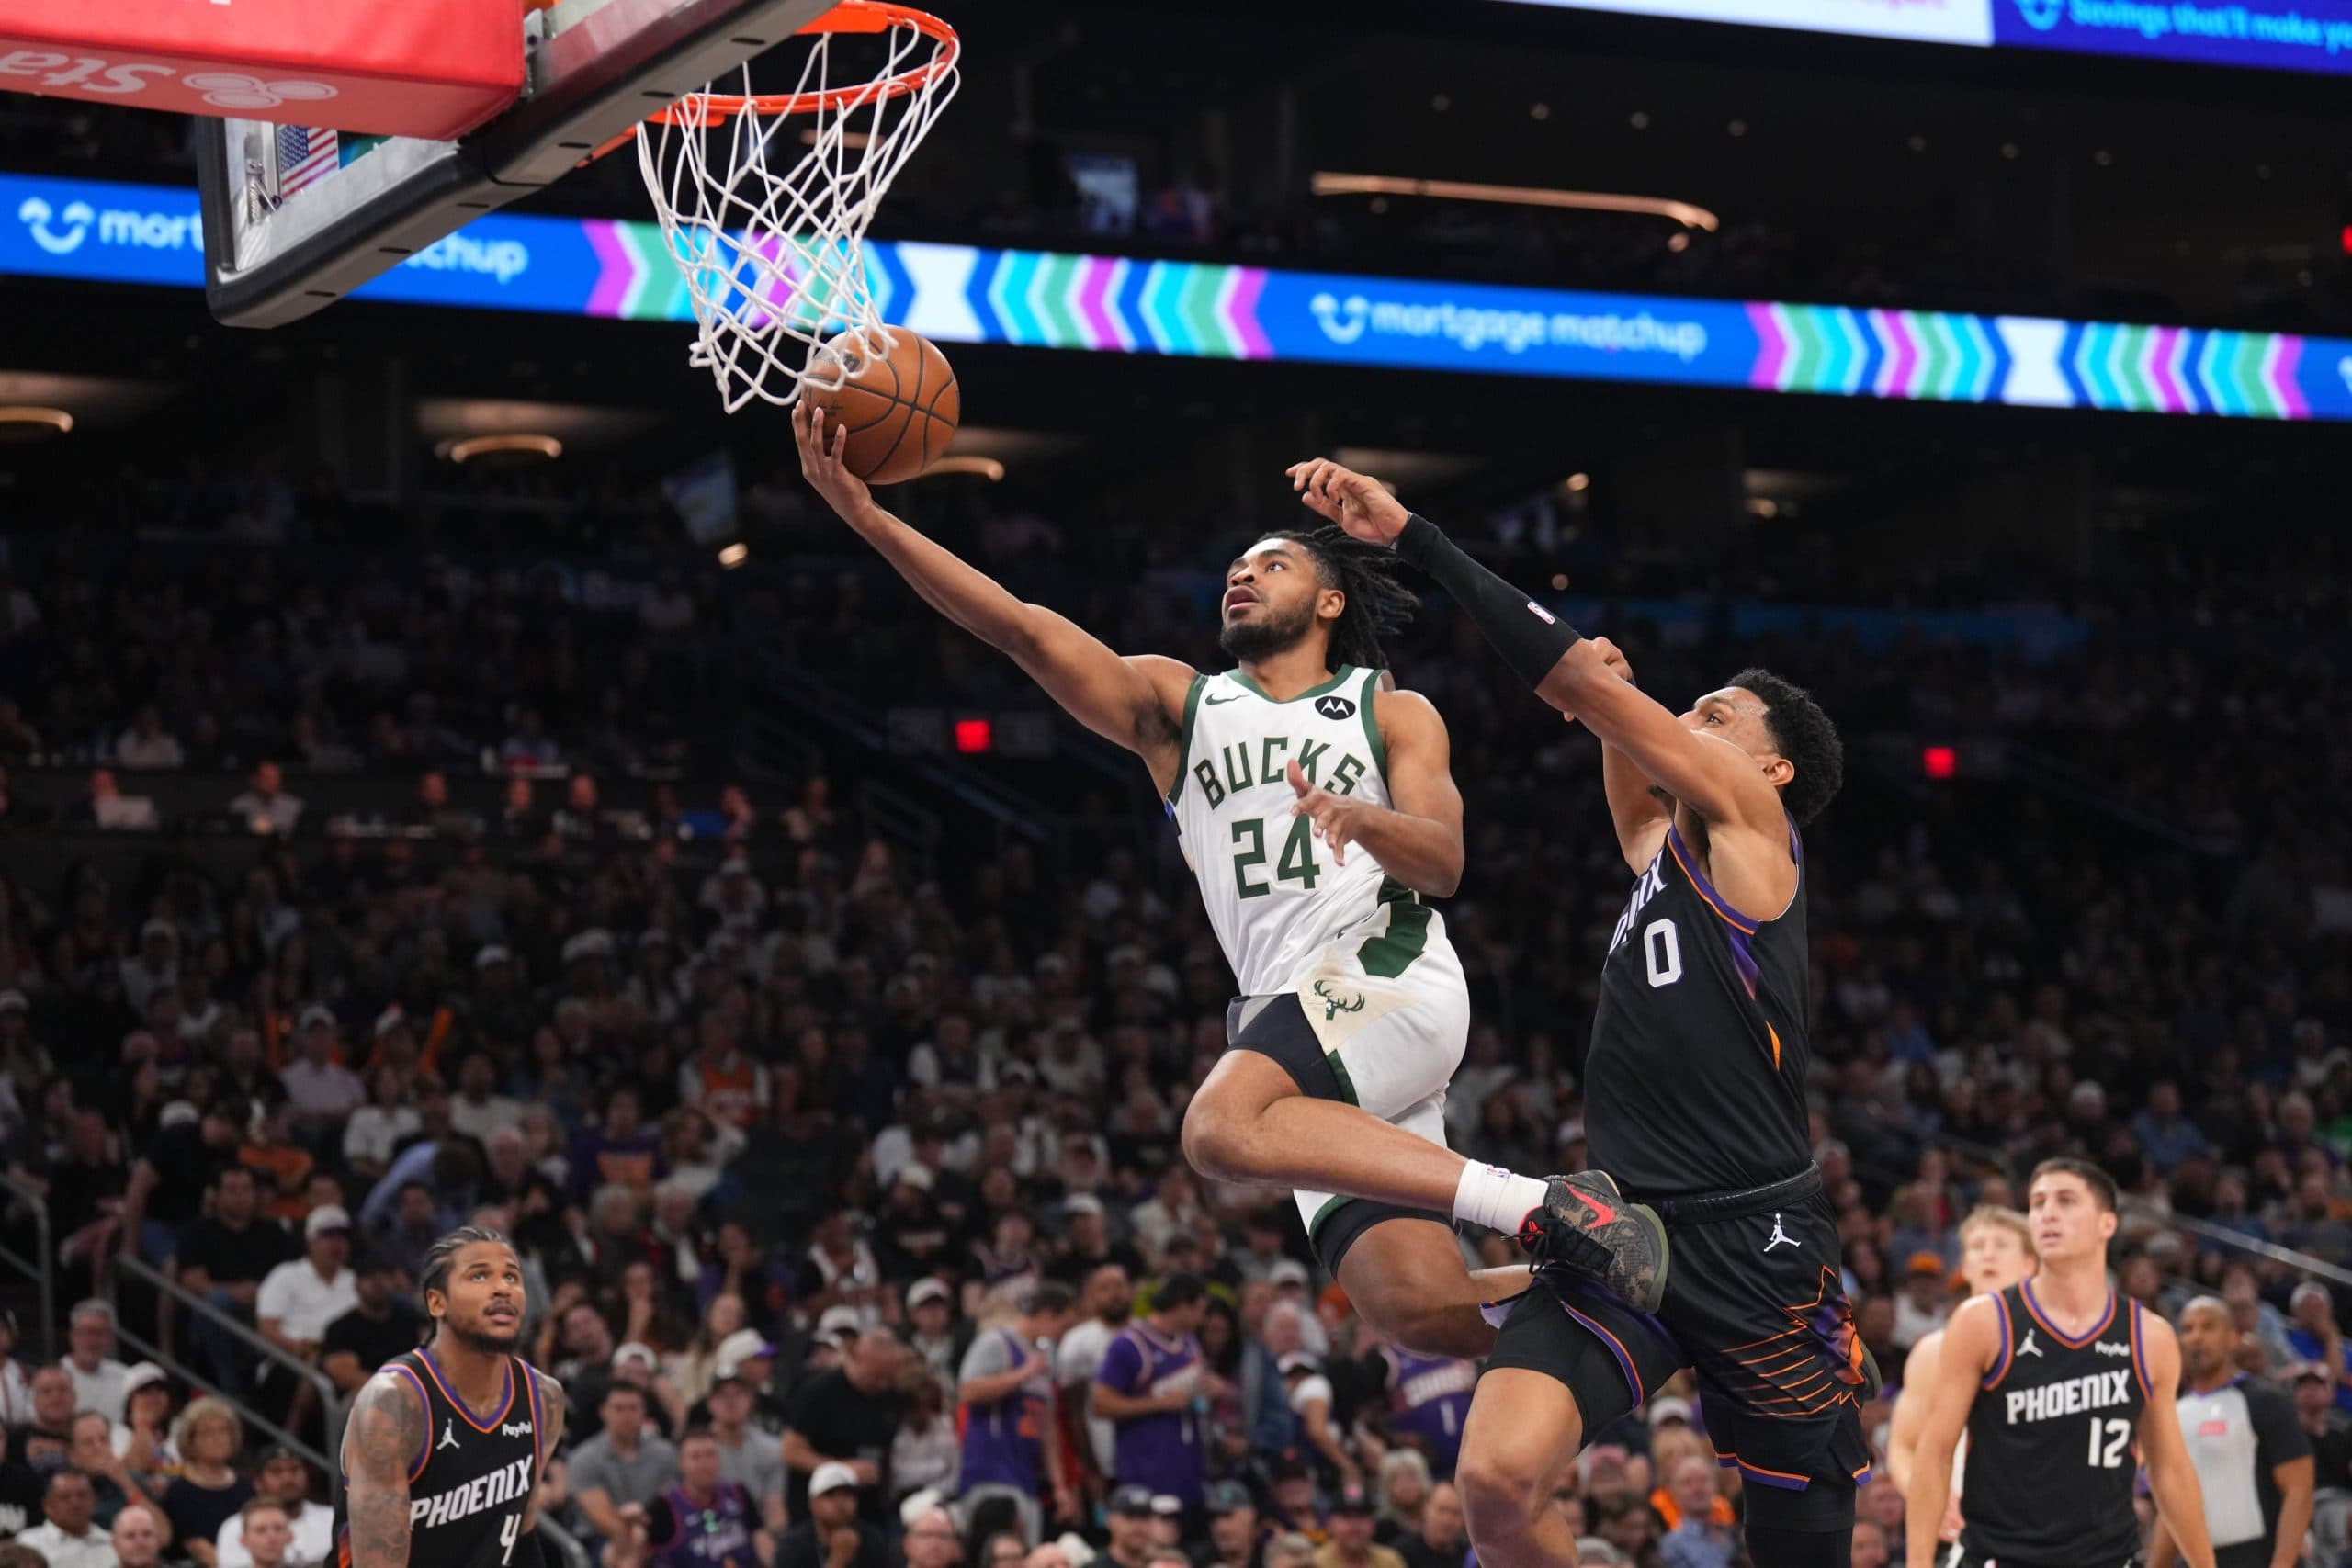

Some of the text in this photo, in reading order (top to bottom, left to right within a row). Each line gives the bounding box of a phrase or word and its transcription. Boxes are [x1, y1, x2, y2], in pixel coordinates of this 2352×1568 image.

[1372, 302, 1708, 363] mortgage matchup
[1194, 736, 1366, 810] BUCKS
[1231, 812, 1321, 899] 24
[1644, 918, 1682, 987] 0
[2006, 1368, 2131, 1425] PHOENIX
[502, 1421, 533, 1438] PayPal
[2088, 1416, 2132, 1468] 12
[410, 1452, 534, 1531] PHOENIX
[500, 1513, 521, 1566] 4
